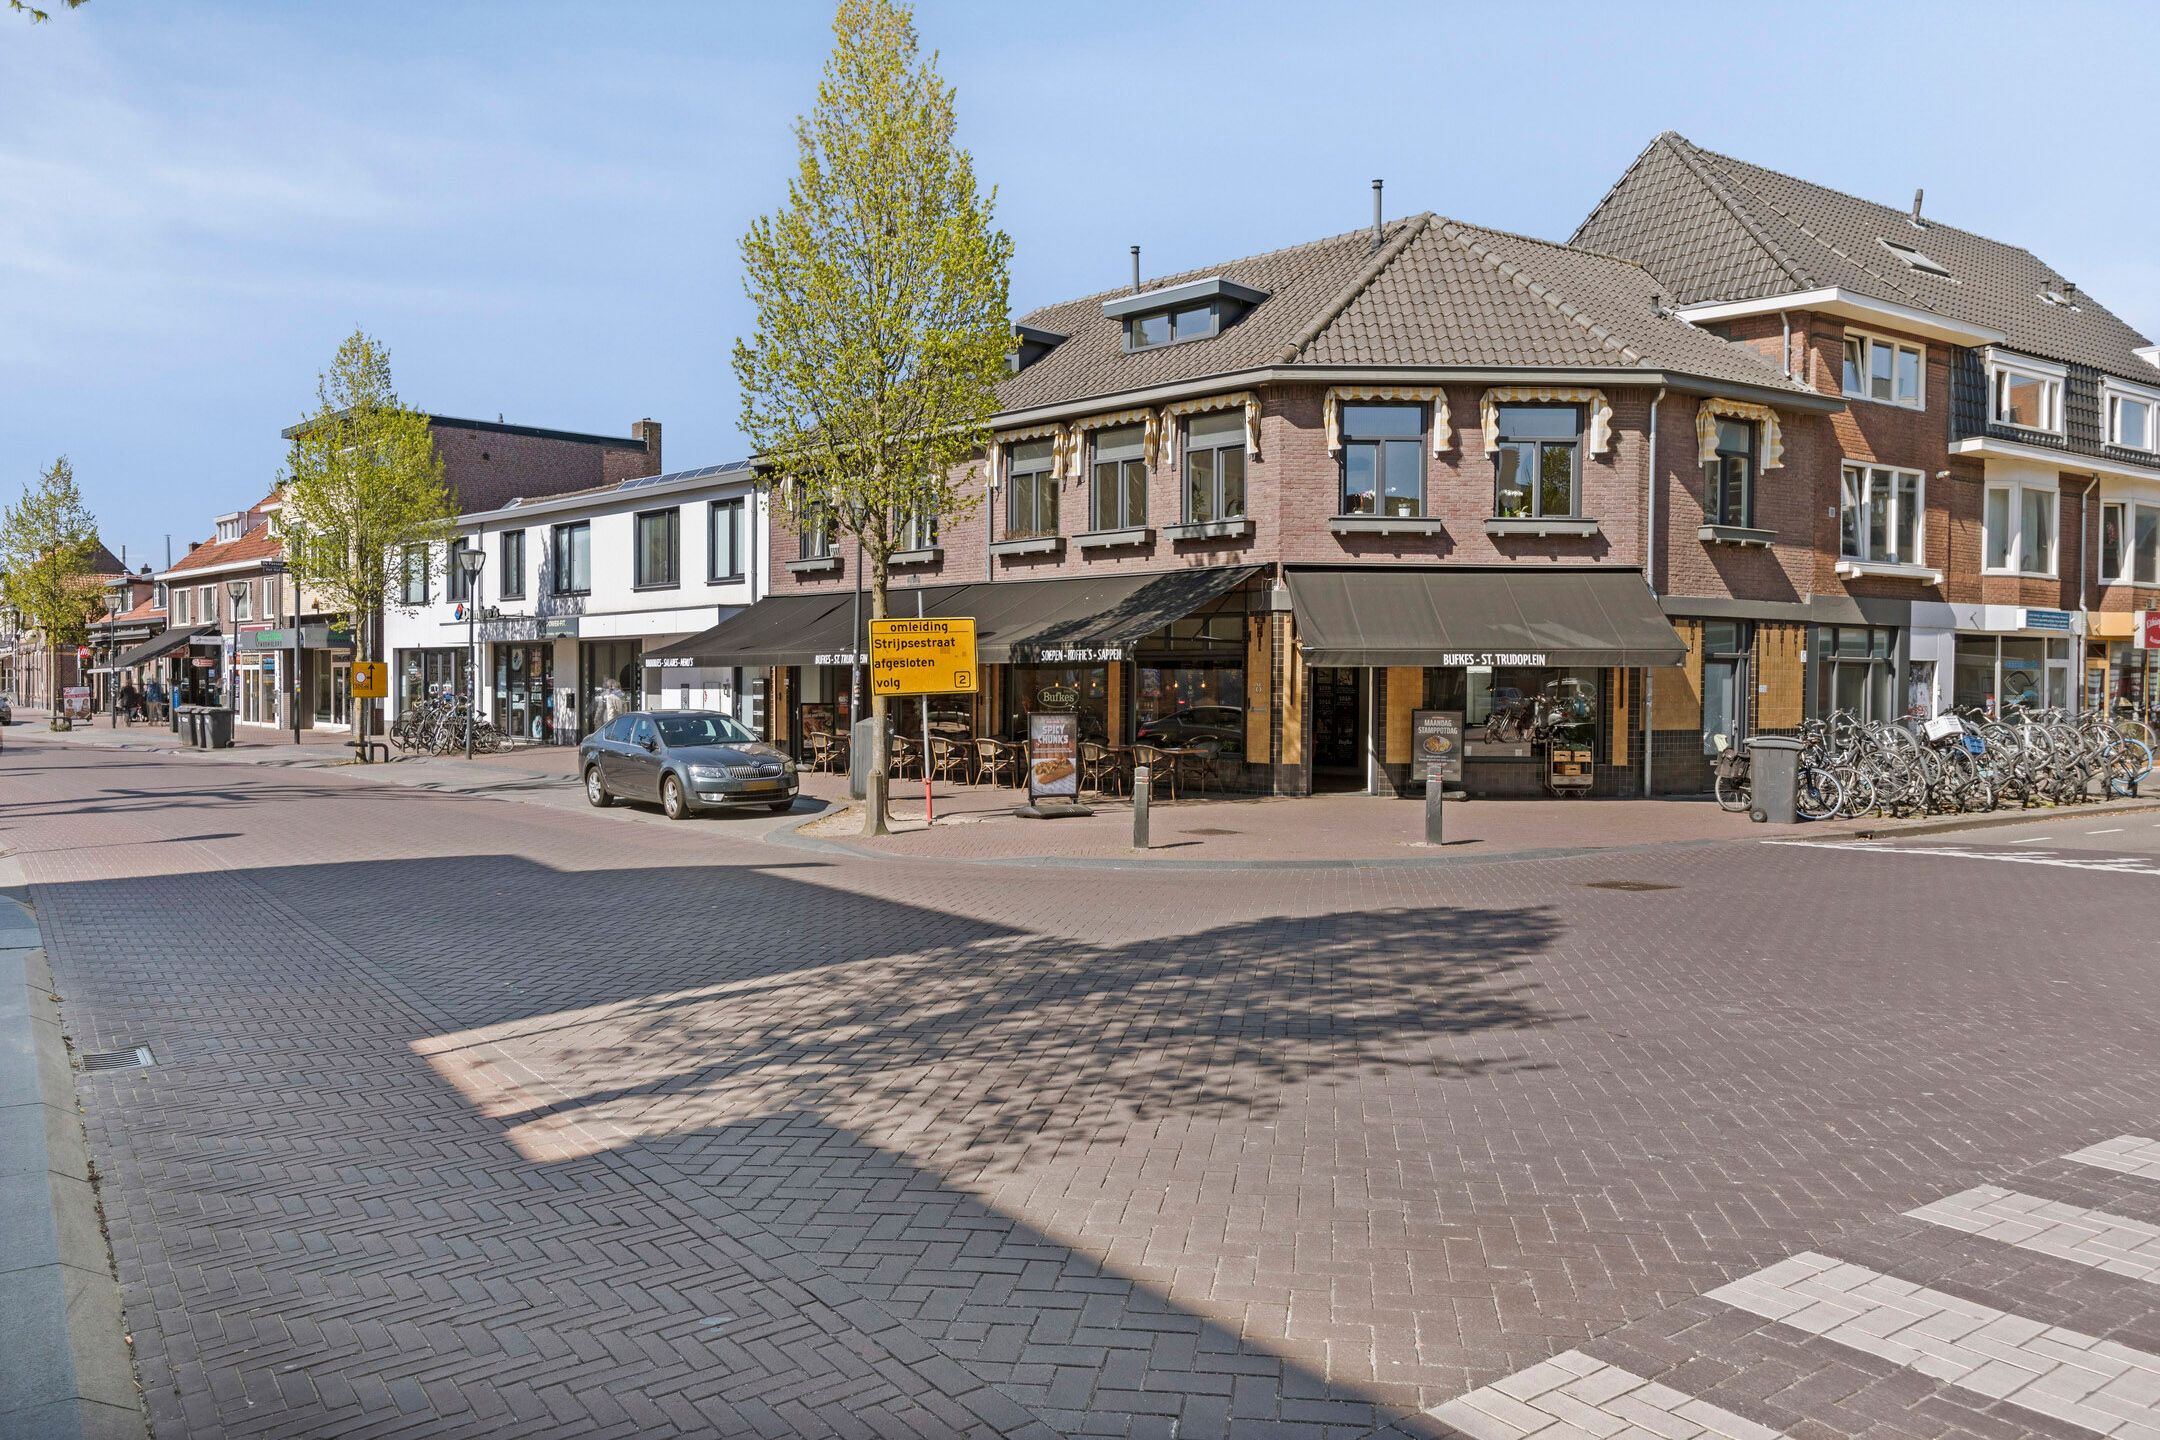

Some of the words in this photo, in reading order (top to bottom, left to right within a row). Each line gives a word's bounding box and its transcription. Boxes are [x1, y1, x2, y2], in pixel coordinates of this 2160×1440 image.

[890, 622, 948, 634] omleiding
[874, 637, 956, 651] Strijpsestraat
[815, 654, 832, 664] BUFKES
[1041, 649, 1063, 661] SOEPEN
[1067, 648, 1093, 661] KOFFIE'S
[1097, 648, 1122, 660] SAPPEN
[1443, 653, 1474, 665] BUFKES
[1481, 653, 1494, 665] ST.
[1495, 653, 1546, 666] TRUDOPLEIN
[874, 657, 935, 671] afgesloten
[876, 677, 901, 690] volg
[959, 675, 966, 684] 2
[1043, 691, 1075, 703] Bufkes
[1424, 719, 1453, 727] MAANDAG
[1042, 724, 1065, 735] SPICY
[1417, 727, 1458, 735] STAMPPOTDAG
[1038, 734, 1069, 744] CHUNKS
